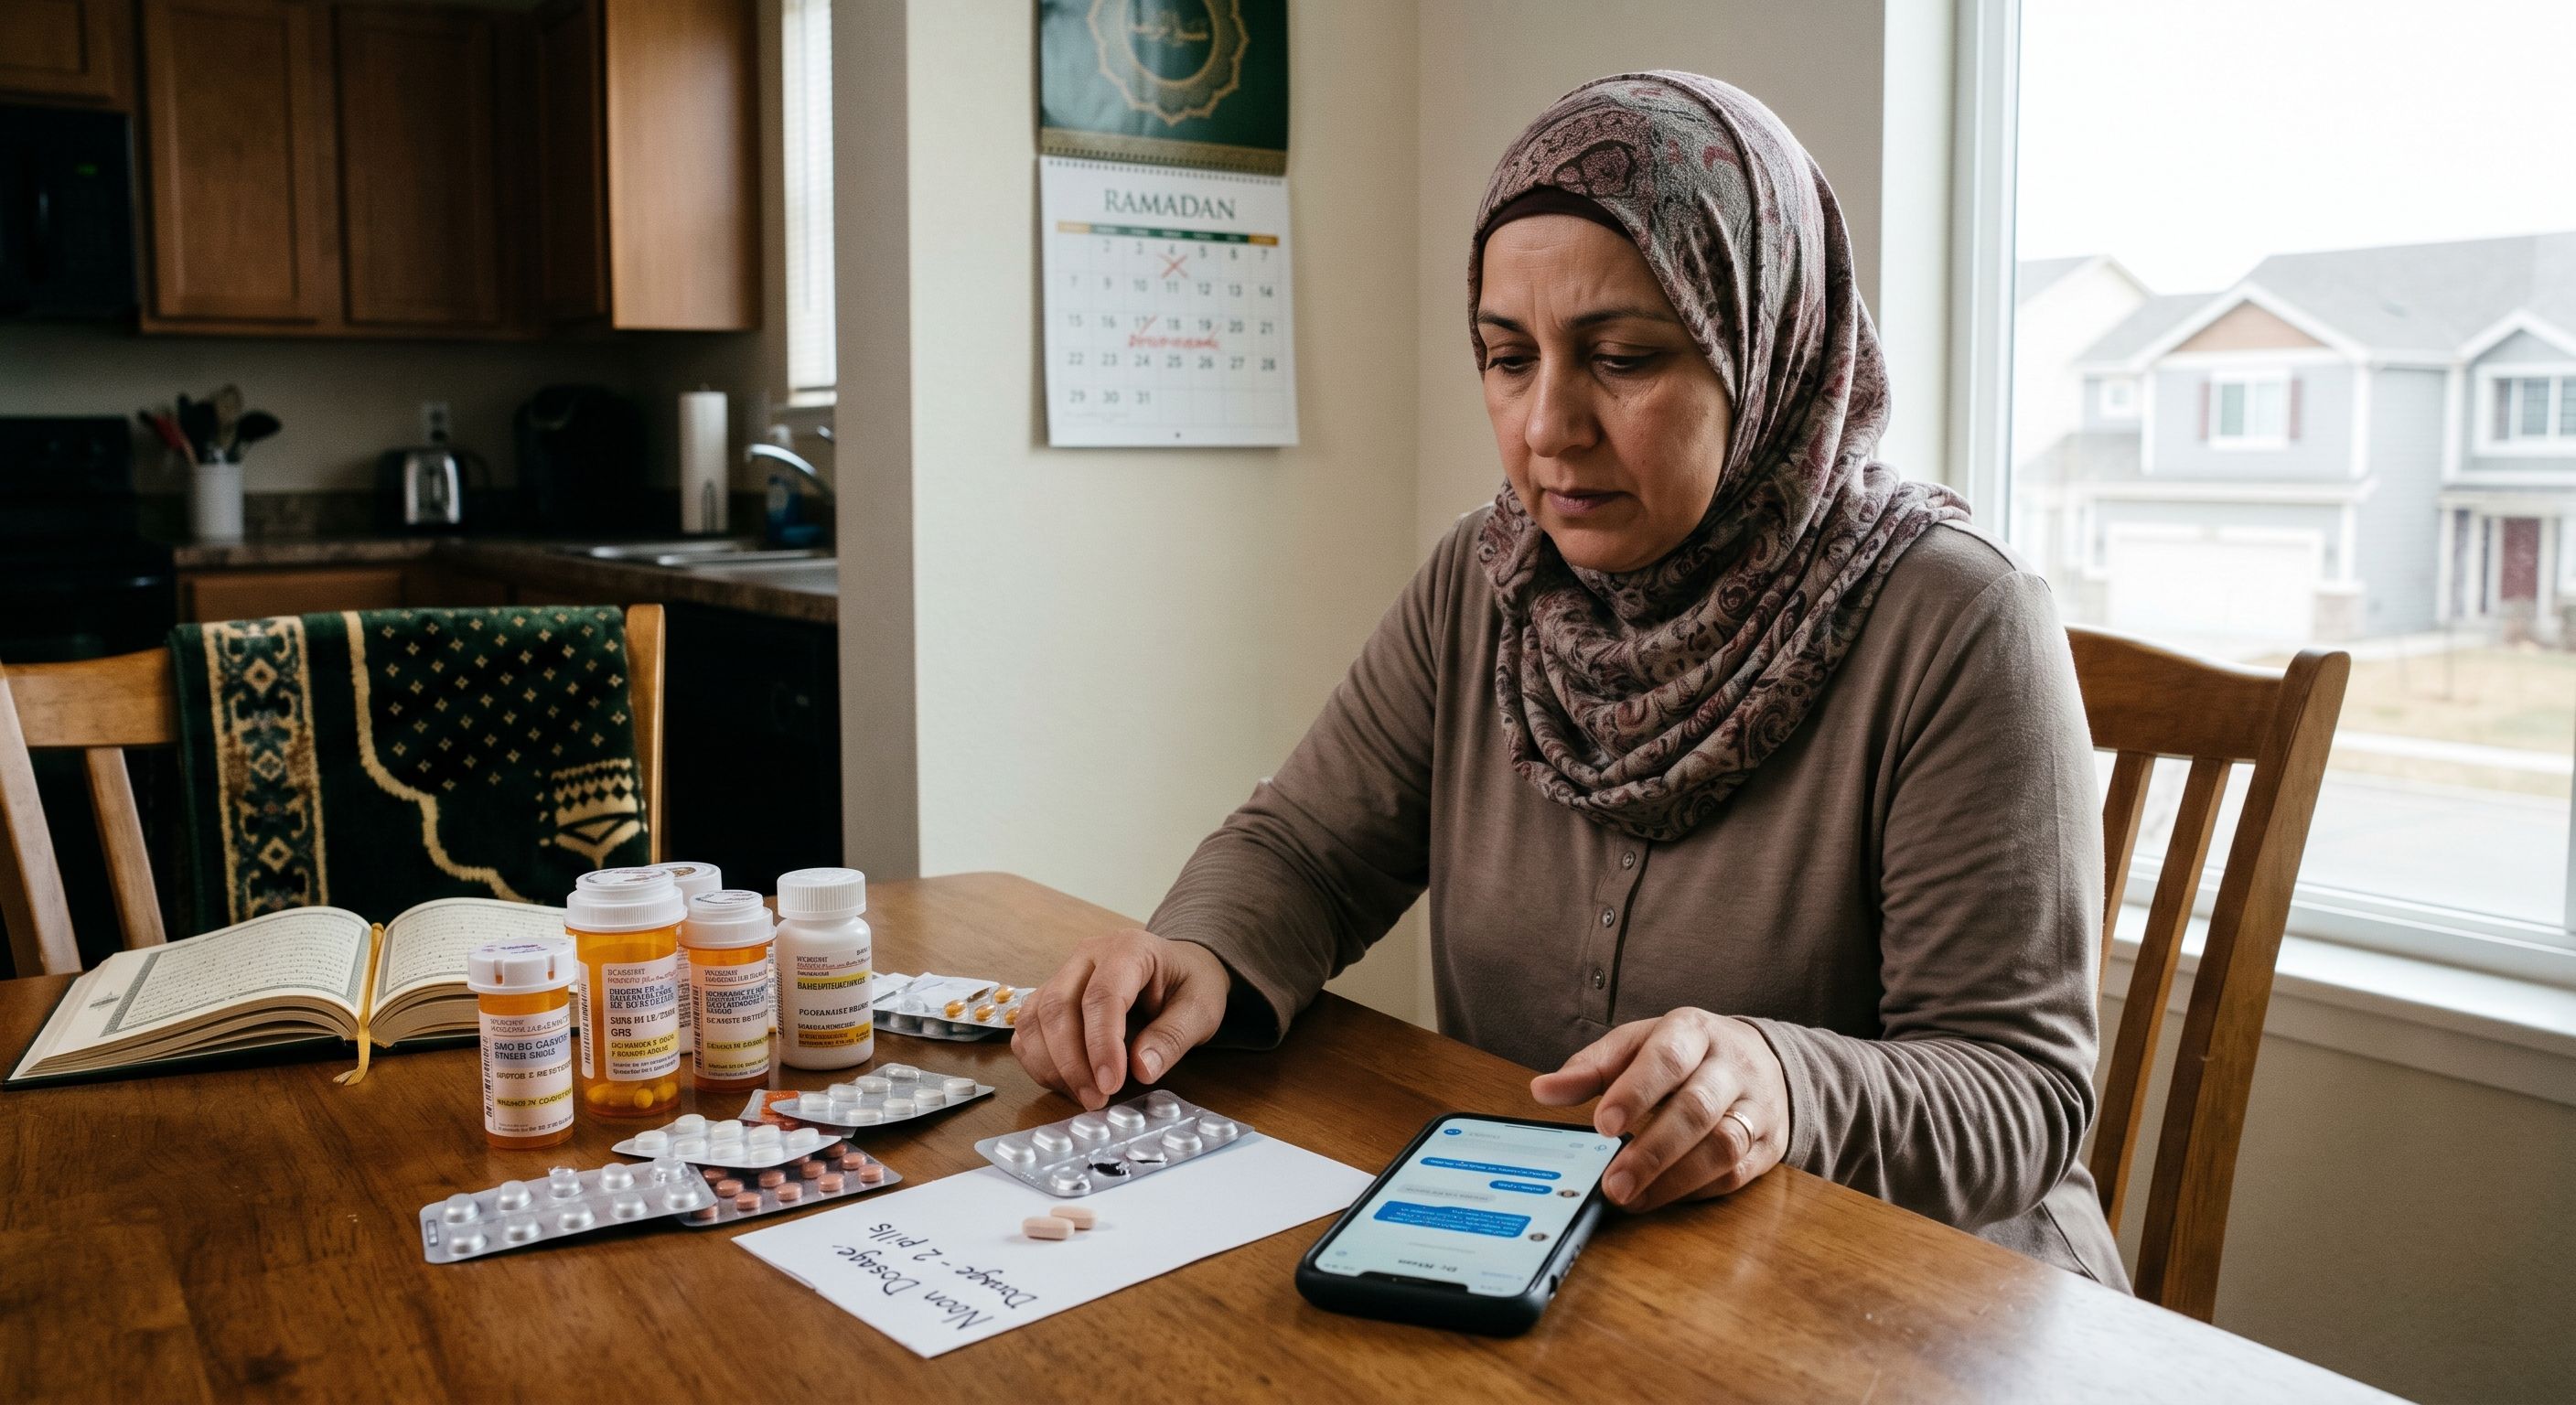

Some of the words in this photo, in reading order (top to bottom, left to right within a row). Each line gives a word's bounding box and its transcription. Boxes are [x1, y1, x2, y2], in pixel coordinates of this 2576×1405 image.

[1104, 188, 1235, 220] RAMADAN
[1198, 244, 1208, 260] 5
[1229, 246, 1239, 261] 6
[1261, 248, 1269, 263] 7
[1133, 278, 1148, 293] 10
[1165, 280, 1179, 294] 11
[1197, 281, 1212, 296] 12
[1228, 283, 1243, 298] 13
[1259, 284, 1274, 298] 14
[1068, 314, 1083, 327] 15
[1100, 315, 1117, 329] 16
[1166, 316, 1181, 330] 18
[1198, 318, 1212, 331] 19
[1229, 319, 1244, 333] 20
[1260, 320, 1274, 335] 21
[1068, 351, 1085, 366] 22
[1101, 352, 1118, 367] 23
[1134, 354, 1150, 368] 24
[1167, 354, 1183, 369] 25
[1198, 355, 1214, 370] 26
[1229, 355, 1245, 370] 27
[1260, 357, 1276, 372] 28
[1069, 390, 1086, 403] 29
[1102, 391, 1121, 403] 30
[1135, 391, 1151, 404] 31
[869, 1222, 929, 1249] pills
[912, 1248, 943, 1261] 2
[924, 1290, 994, 1331] Noon
